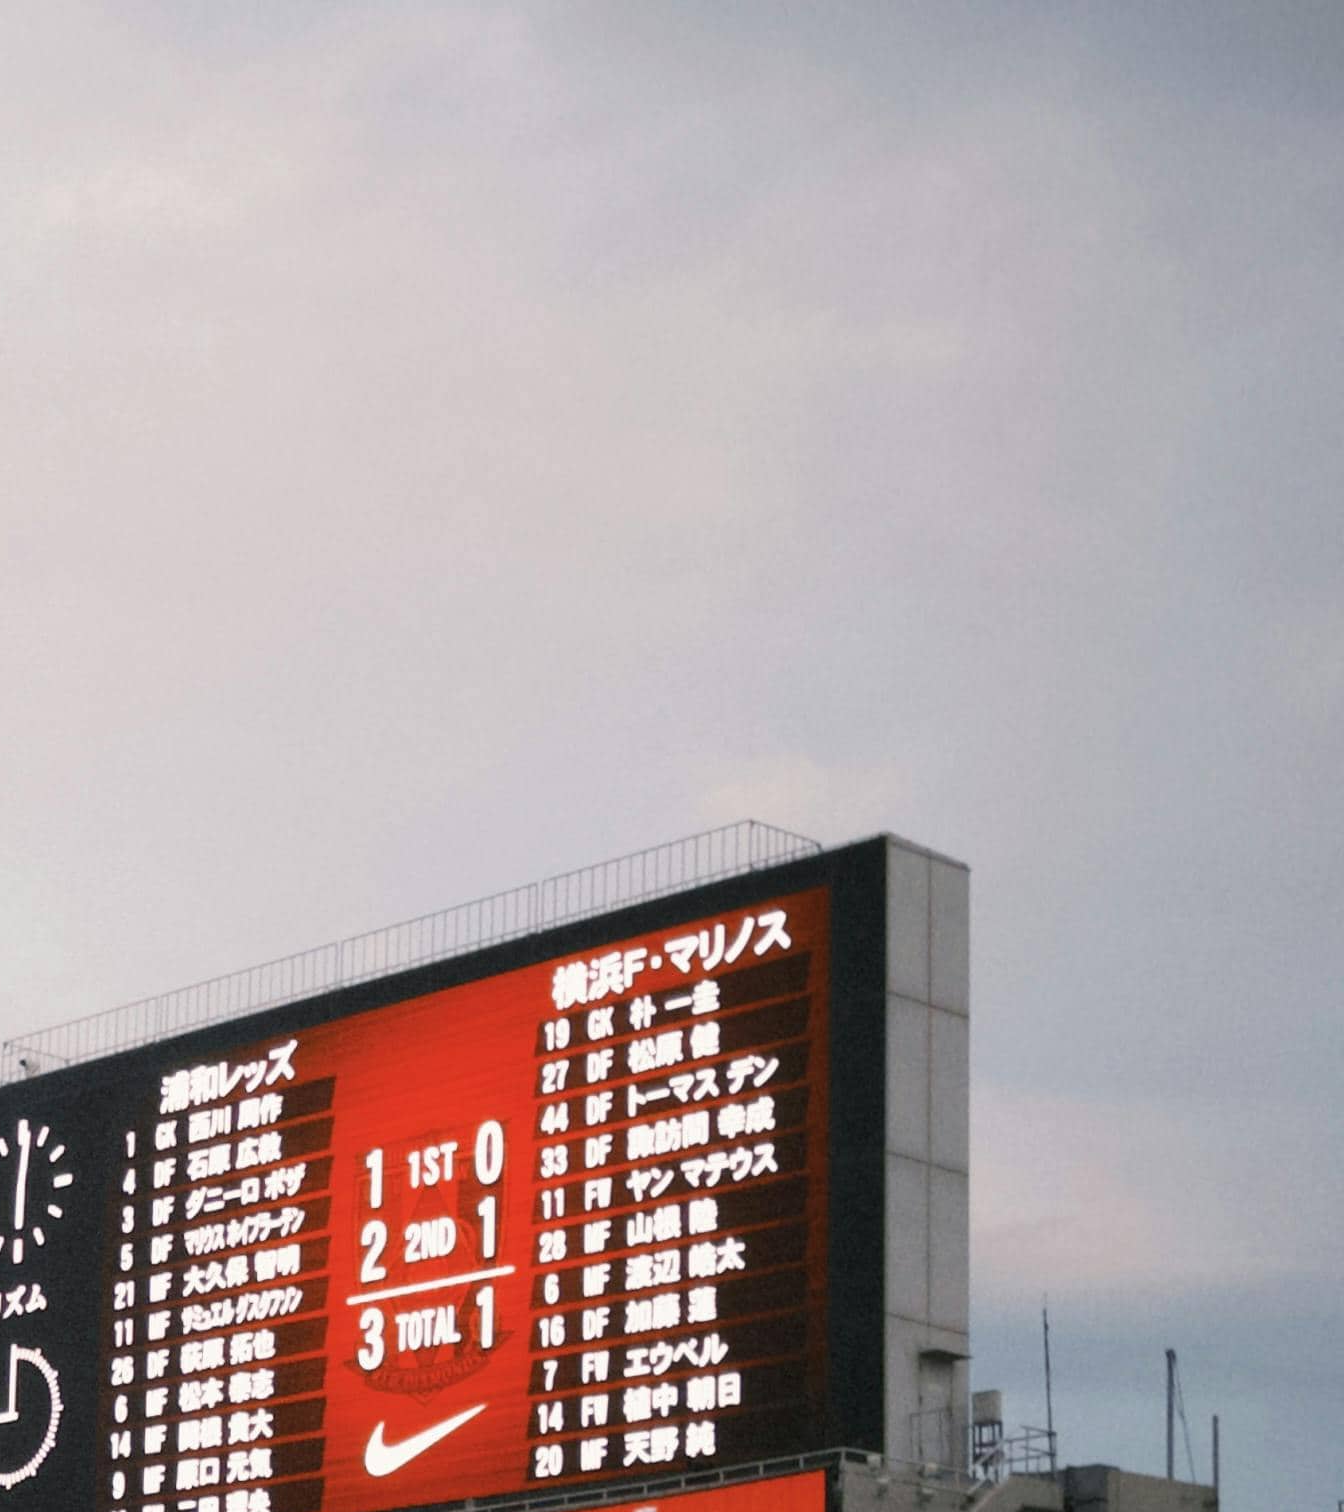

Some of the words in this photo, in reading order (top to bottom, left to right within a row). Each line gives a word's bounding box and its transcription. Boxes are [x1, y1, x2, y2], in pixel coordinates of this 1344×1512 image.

[544, 1018, 570, 1051] 19
[587, 1006, 614, 1041] GK
[160, 1039, 298, 1114] 浦和レッズ
[541, 1059, 569, 1094] 27
[586, 1048, 614, 1084] DF
[628, 1030, 684, 1074] 松原
[540, 1102, 569, 1135] 44
[585, 1091, 613, 1127] DF
[627, 1068, 719, 1118] トーマス
[726, 1055, 780, 1094] デン
[126, 1131, 136, 1158] 1
[188, 1105, 232, 1143] 西川
[540, 1145, 568, 1179] 33
[585, 1133, 613, 1169] DF
[122, 1168, 136, 1195] 4
[153, 1157, 176, 1189] DF
[187, 1143, 231, 1181] 石原
[366, 1148, 383, 1209] 1
[408, 1142, 458, 1189] 1ST
[475, 1120, 505, 1185] 0
[541, 1187, 565, 1220] 11
[584, 1177, 612, 1211] FW
[625, 1167, 674, 1202] ヤン
[680, 1142, 778, 1188] マテウス
[122, 1205, 134, 1234] 3
[152, 1196, 175, 1227] DF
[185, 1177, 260, 1220] ダニーロ
[264, 1163, 306, 1200] ボザ
[120, 1243, 133, 1271] 5
[150, 1234, 174, 1265] DF
[361, 1220, 387, 1283] 2
[404, 1217, 456, 1264] 2ND
[478, 1196, 496, 1259] 1
[539, 1230, 567, 1264] 28
[626, 1204, 681, 1247] 山根
[114, 1280, 135, 1311] 21
[183, 1254, 249, 1297] 大久保
[544, 1273, 560, 1305] 6
[114, 1318, 134, 1348] 11
[358, 1307, 385, 1371] 3
[395, 1305, 462, 1352] TOTAL
[476, 1285, 494, 1350] 1
[539, 1315, 566, 1348] 16
[582, 1306, 610, 1340] DF
[624, 1292, 680, 1334] 加藤
[111, 1356, 134, 1386] 26
[146, 1349, 170, 1379] DF
[543, 1360, 558, 1392] 7
[581, 1350, 609, 1385] FW
[623, 1333, 729, 1378] エウベル
[114, 1394, 128, 1423] 6
[179, 1377, 224, 1413] 松本
[537, 1401, 564, 1435] 14
[581, 1394, 609, 1428] FW
[687, 1372, 742, 1413] 朝日
[110, 1430, 131, 1460] 14
[535, 1445, 562, 1478] 20
[623, 1426, 679, 1467] 天野
[112, 1470, 126, 1500] 9
[176, 1457, 221, 1491] 原口
